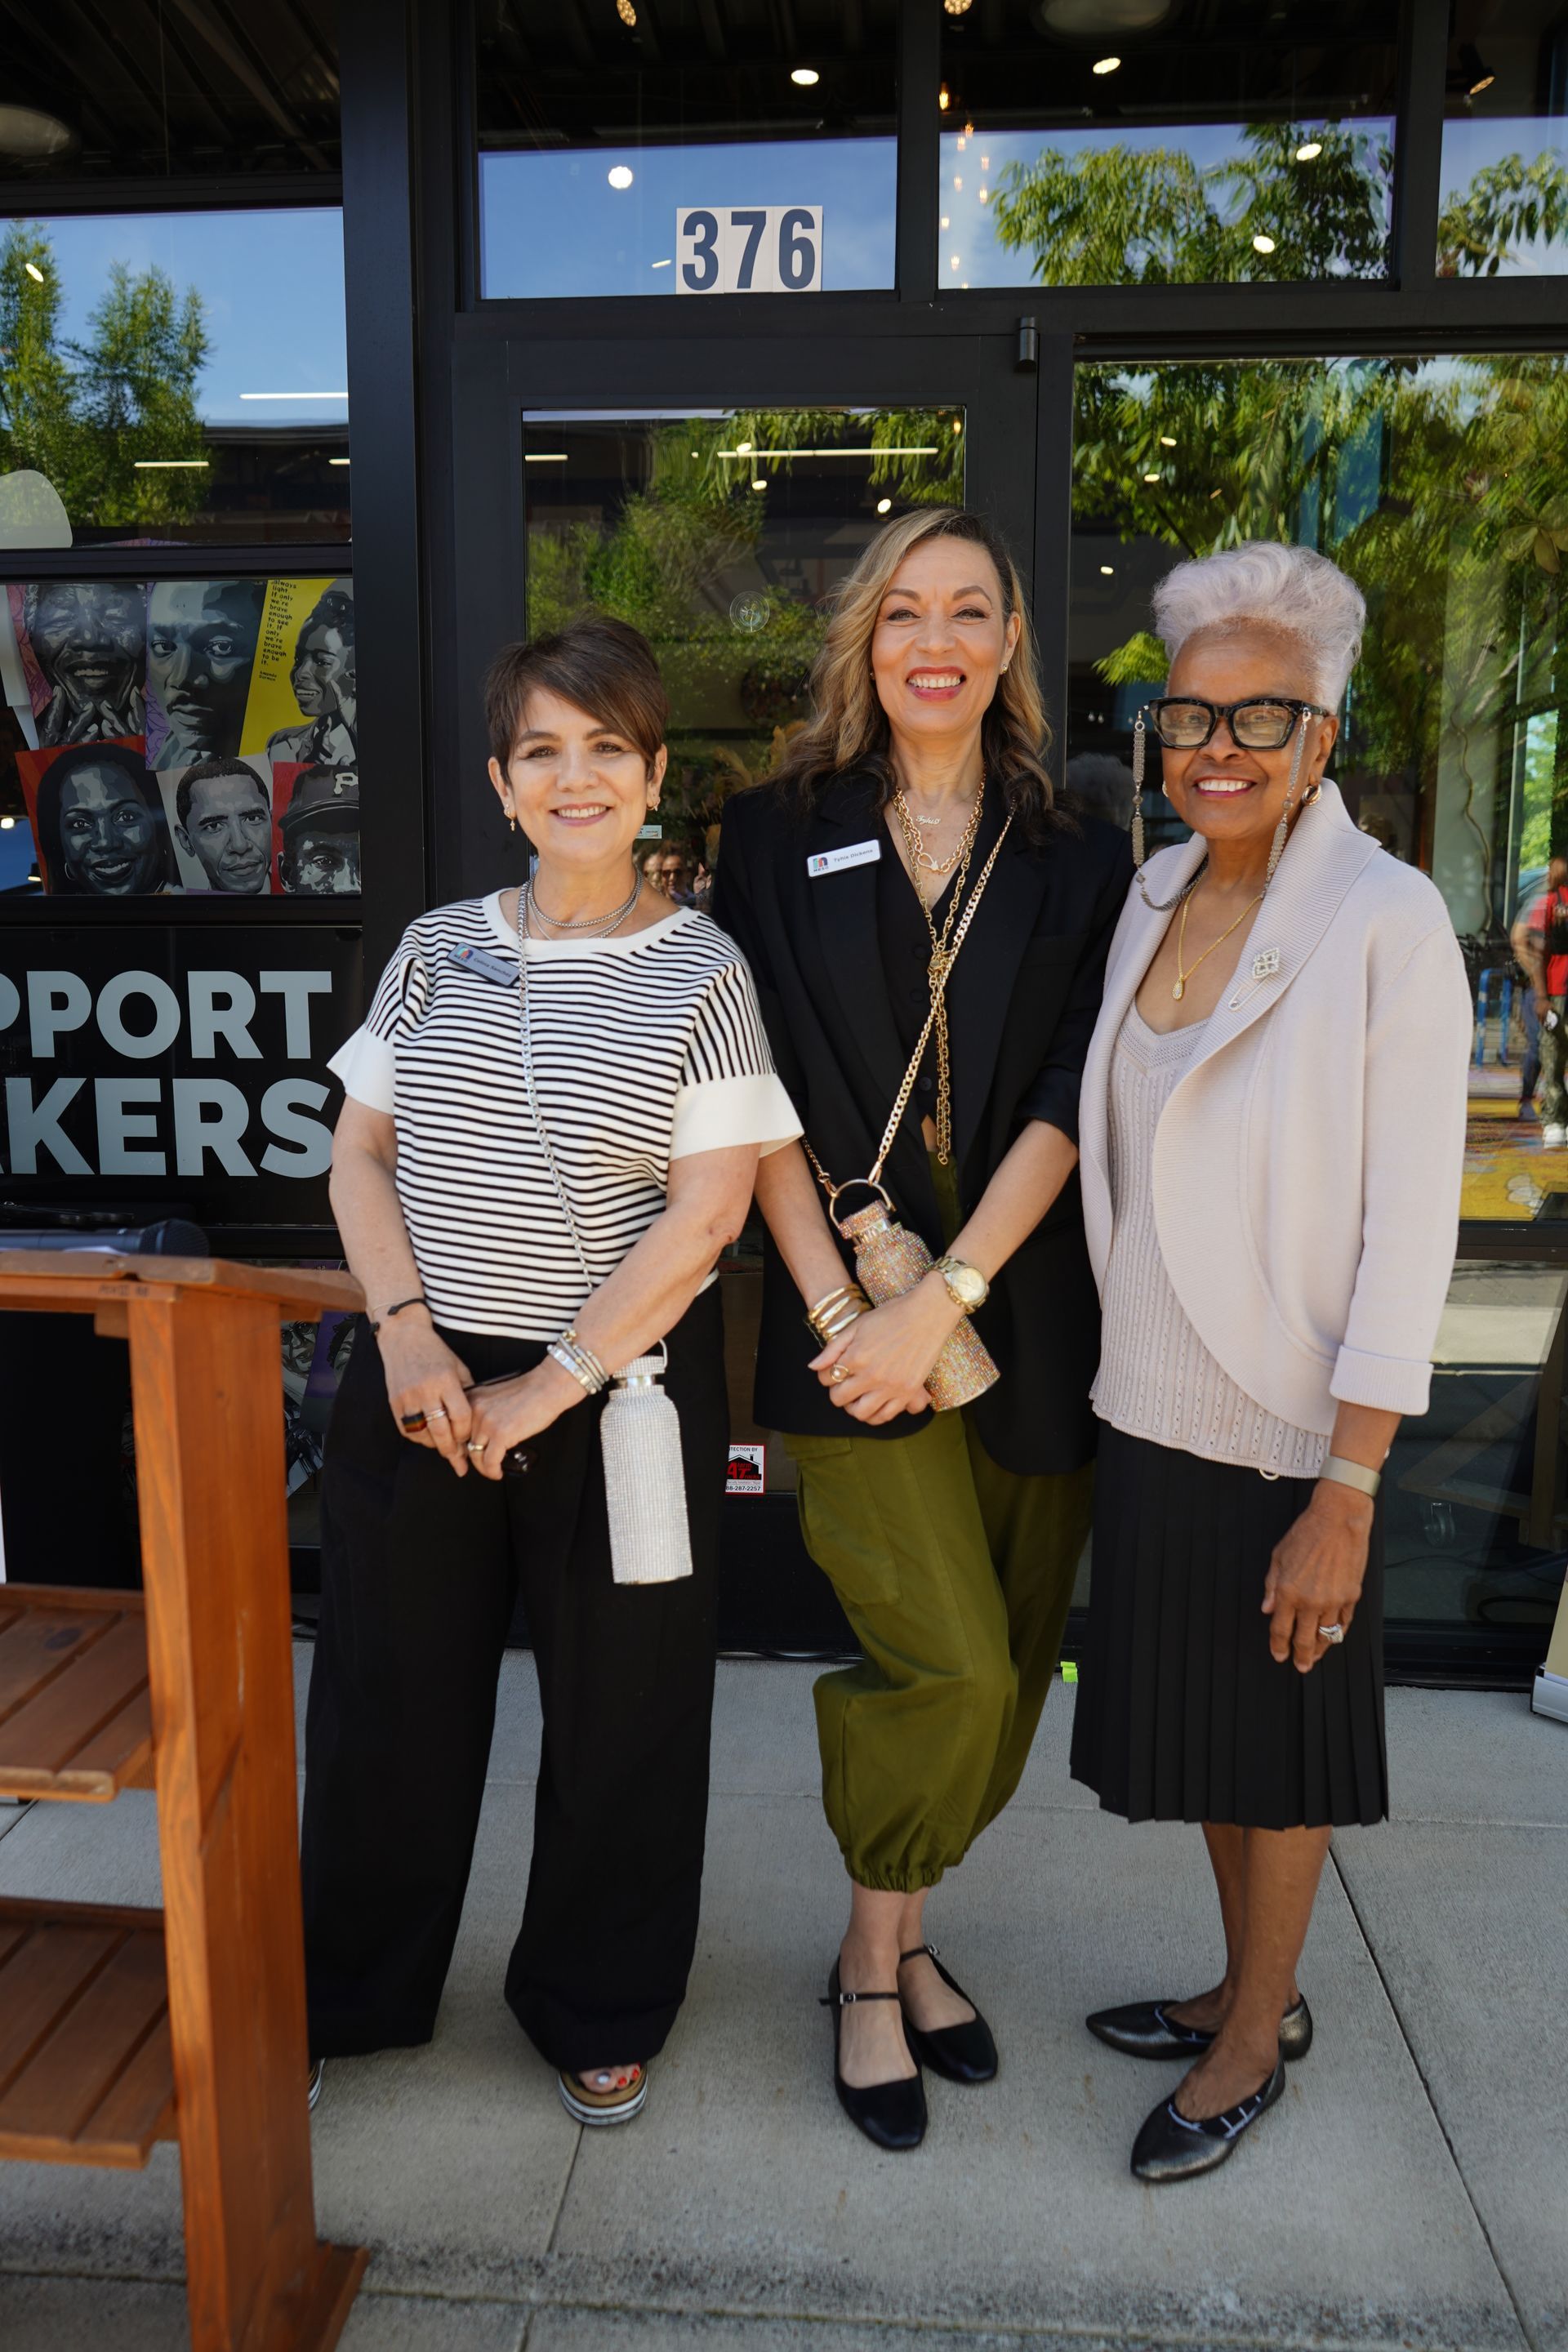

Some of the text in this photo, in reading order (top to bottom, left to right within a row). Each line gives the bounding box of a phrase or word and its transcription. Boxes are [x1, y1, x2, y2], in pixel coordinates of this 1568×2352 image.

[682, 208, 815, 291] 376
[270, 604, 287, 612] brave
[269, 612, 292, 621] enough
[263, 641, 283, 650] brave
[263, 648, 287, 657] enough
